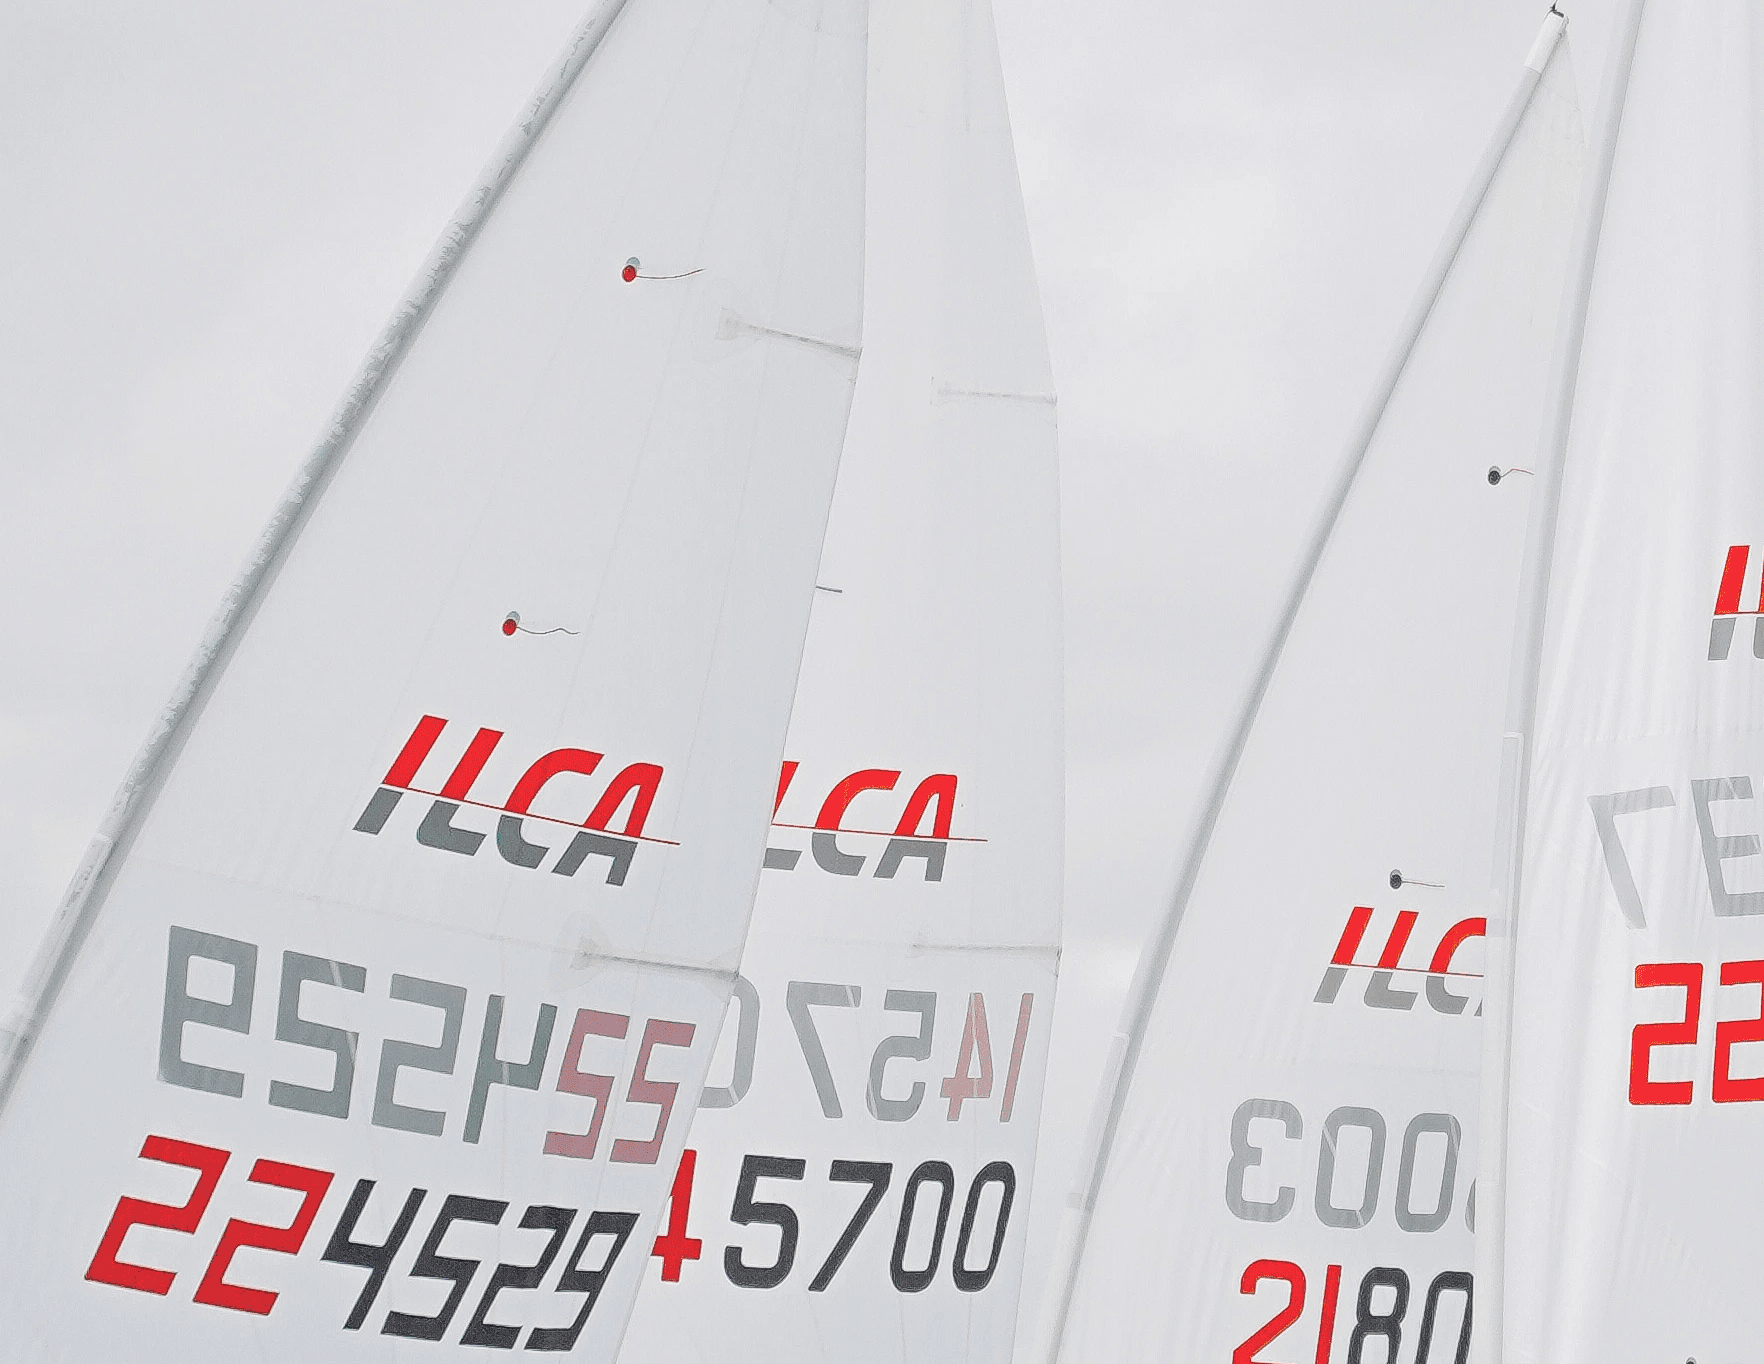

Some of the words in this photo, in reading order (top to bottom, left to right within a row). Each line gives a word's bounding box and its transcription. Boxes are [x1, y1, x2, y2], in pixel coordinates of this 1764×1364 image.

[352, 715, 665, 887] ILCA
[1313, 906, 1487, 1017] ILC
[84, 1135, 641, 1352] 224529
